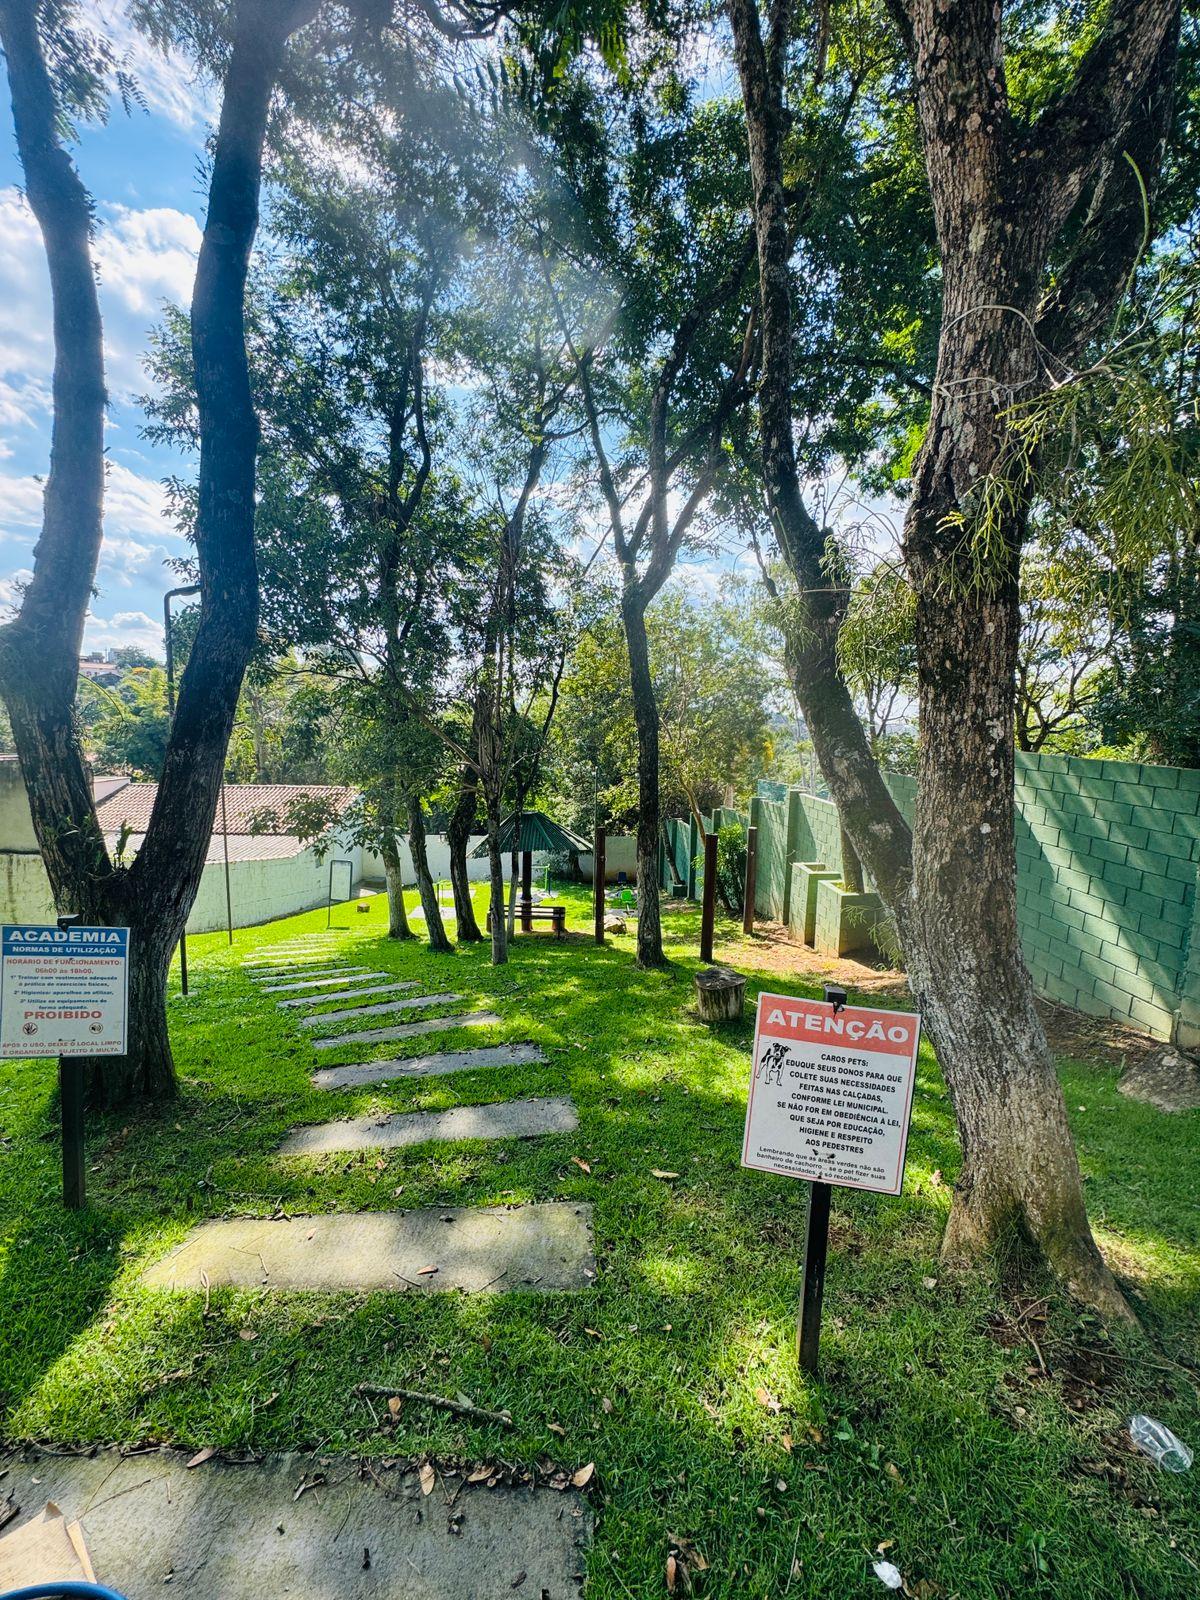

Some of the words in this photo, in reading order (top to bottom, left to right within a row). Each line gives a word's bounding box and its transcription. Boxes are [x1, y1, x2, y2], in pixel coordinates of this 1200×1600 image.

[9, 930, 120, 942] ACADEMIA
[24, 1011, 102, 1020] PROIBIDO
[766, 1008, 909, 1043] ATENÇÃO
[786, 1059, 816, 1070] EDUQUE
[816, 1064, 836, 1073] SEUS
[838, 1067, 864, 1077] DONOS
[866, 1072, 885, 1080] PARA
[886, 1074, 903, 1083] QUE
[821, 1054, 846, 1064] CAROS
[848, 1058, 869, 1067] PETS:
[790, 1070, 818, 1081] COLETE
[820, 1076, 838, 1084] SUAS
[840, 1078, 896, 1093] NECESSIDADES
[792, 1092, 831, 1105] CONFORME
[846, 1102, 888, 1114] MUNICIPAL.
[799, 1083, 824, 1093] FEITAS
[826, 1087, 840, 1096] NAS
[842, 1090, 883, 1103] CALÇADAS,
[788, 1103, 803, 1111] NÃO
[805, 1106, 820, 1114] FOR
[834, 1110, 878, 1124] OBEDIÊNCIA
[887, 1119, 901, 1128] LEI,
[790, 1114, 804, 1122] QUE
[806, 1116, 825, 1126] SEJA
[826, 1120, 842, 1128] POR
[843, 1123, 885, 1136] EDUCAÇÃO,
[800, 1126, 829, 1137] HIGIENE
[838, 1133, 873, 1144] RESPEITO
[806, 1138, 820, 1147] AOS
[822, 1141, 864, 1154] PEDESTRES
[760, 1146, 794, 1158] Lembrando
[836, 1160, 858, 1169] verdes
